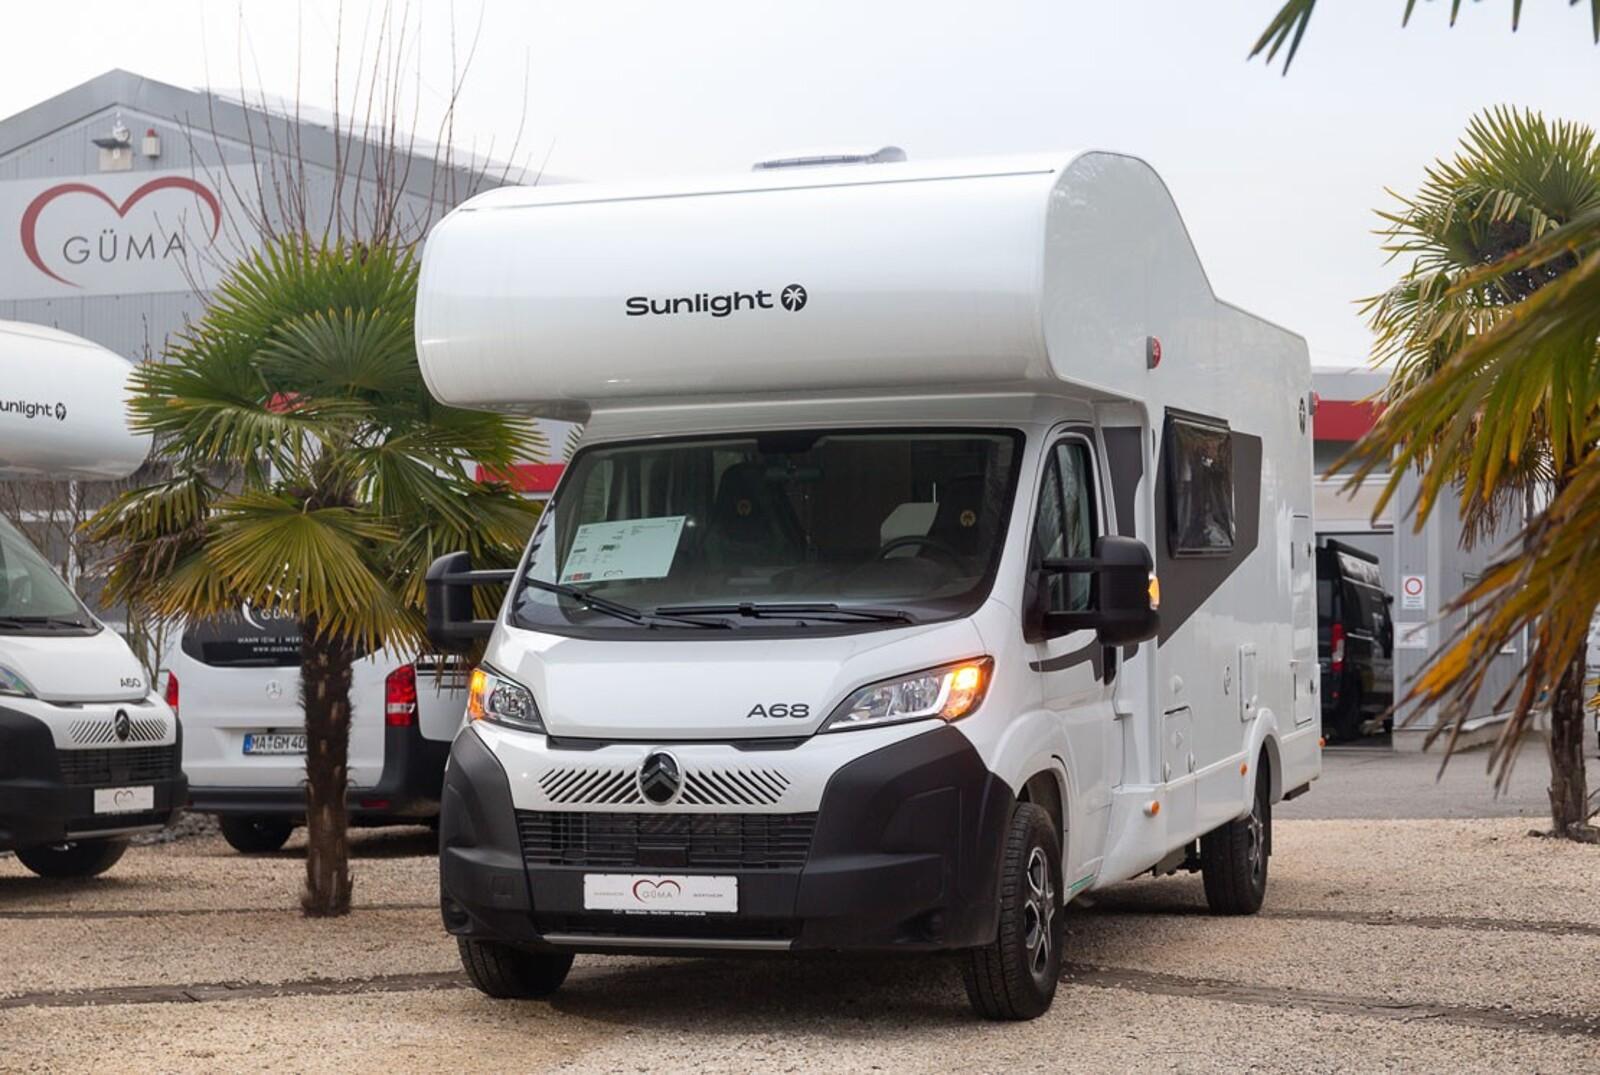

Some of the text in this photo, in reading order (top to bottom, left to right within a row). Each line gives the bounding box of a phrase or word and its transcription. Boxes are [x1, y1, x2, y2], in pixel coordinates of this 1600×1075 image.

[62, 228, 188, 264] GÜMA
[626, 290, 774, 317] Sunlight
[746, 703, 810, 718] A68
